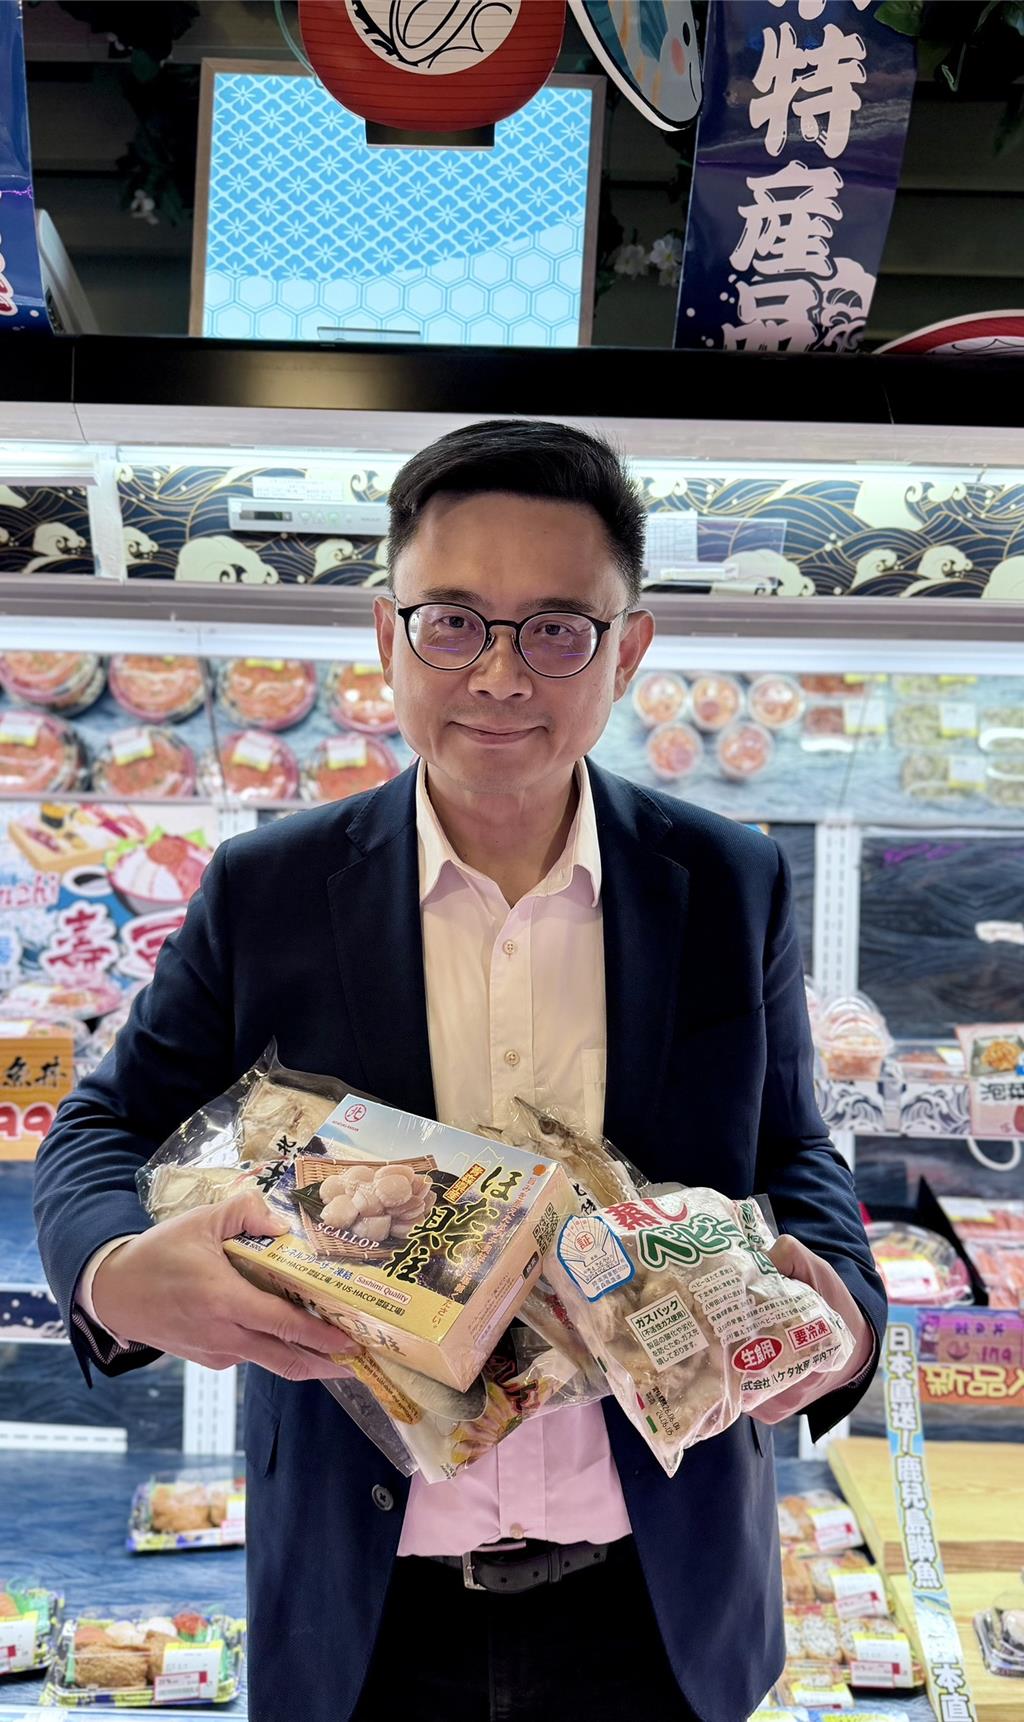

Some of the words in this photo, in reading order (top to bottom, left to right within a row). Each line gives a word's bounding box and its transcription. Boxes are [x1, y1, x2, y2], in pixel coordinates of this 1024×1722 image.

[316, 1222, 380, 1250] SCALLOP
[355, 1274, 384, 1293] Sashimi
[381, 1285, 409, 1304] Quality
[636, 1300, 678, 1328] ガスパック
[793, 1321, 827, 1345] 要冷凍
